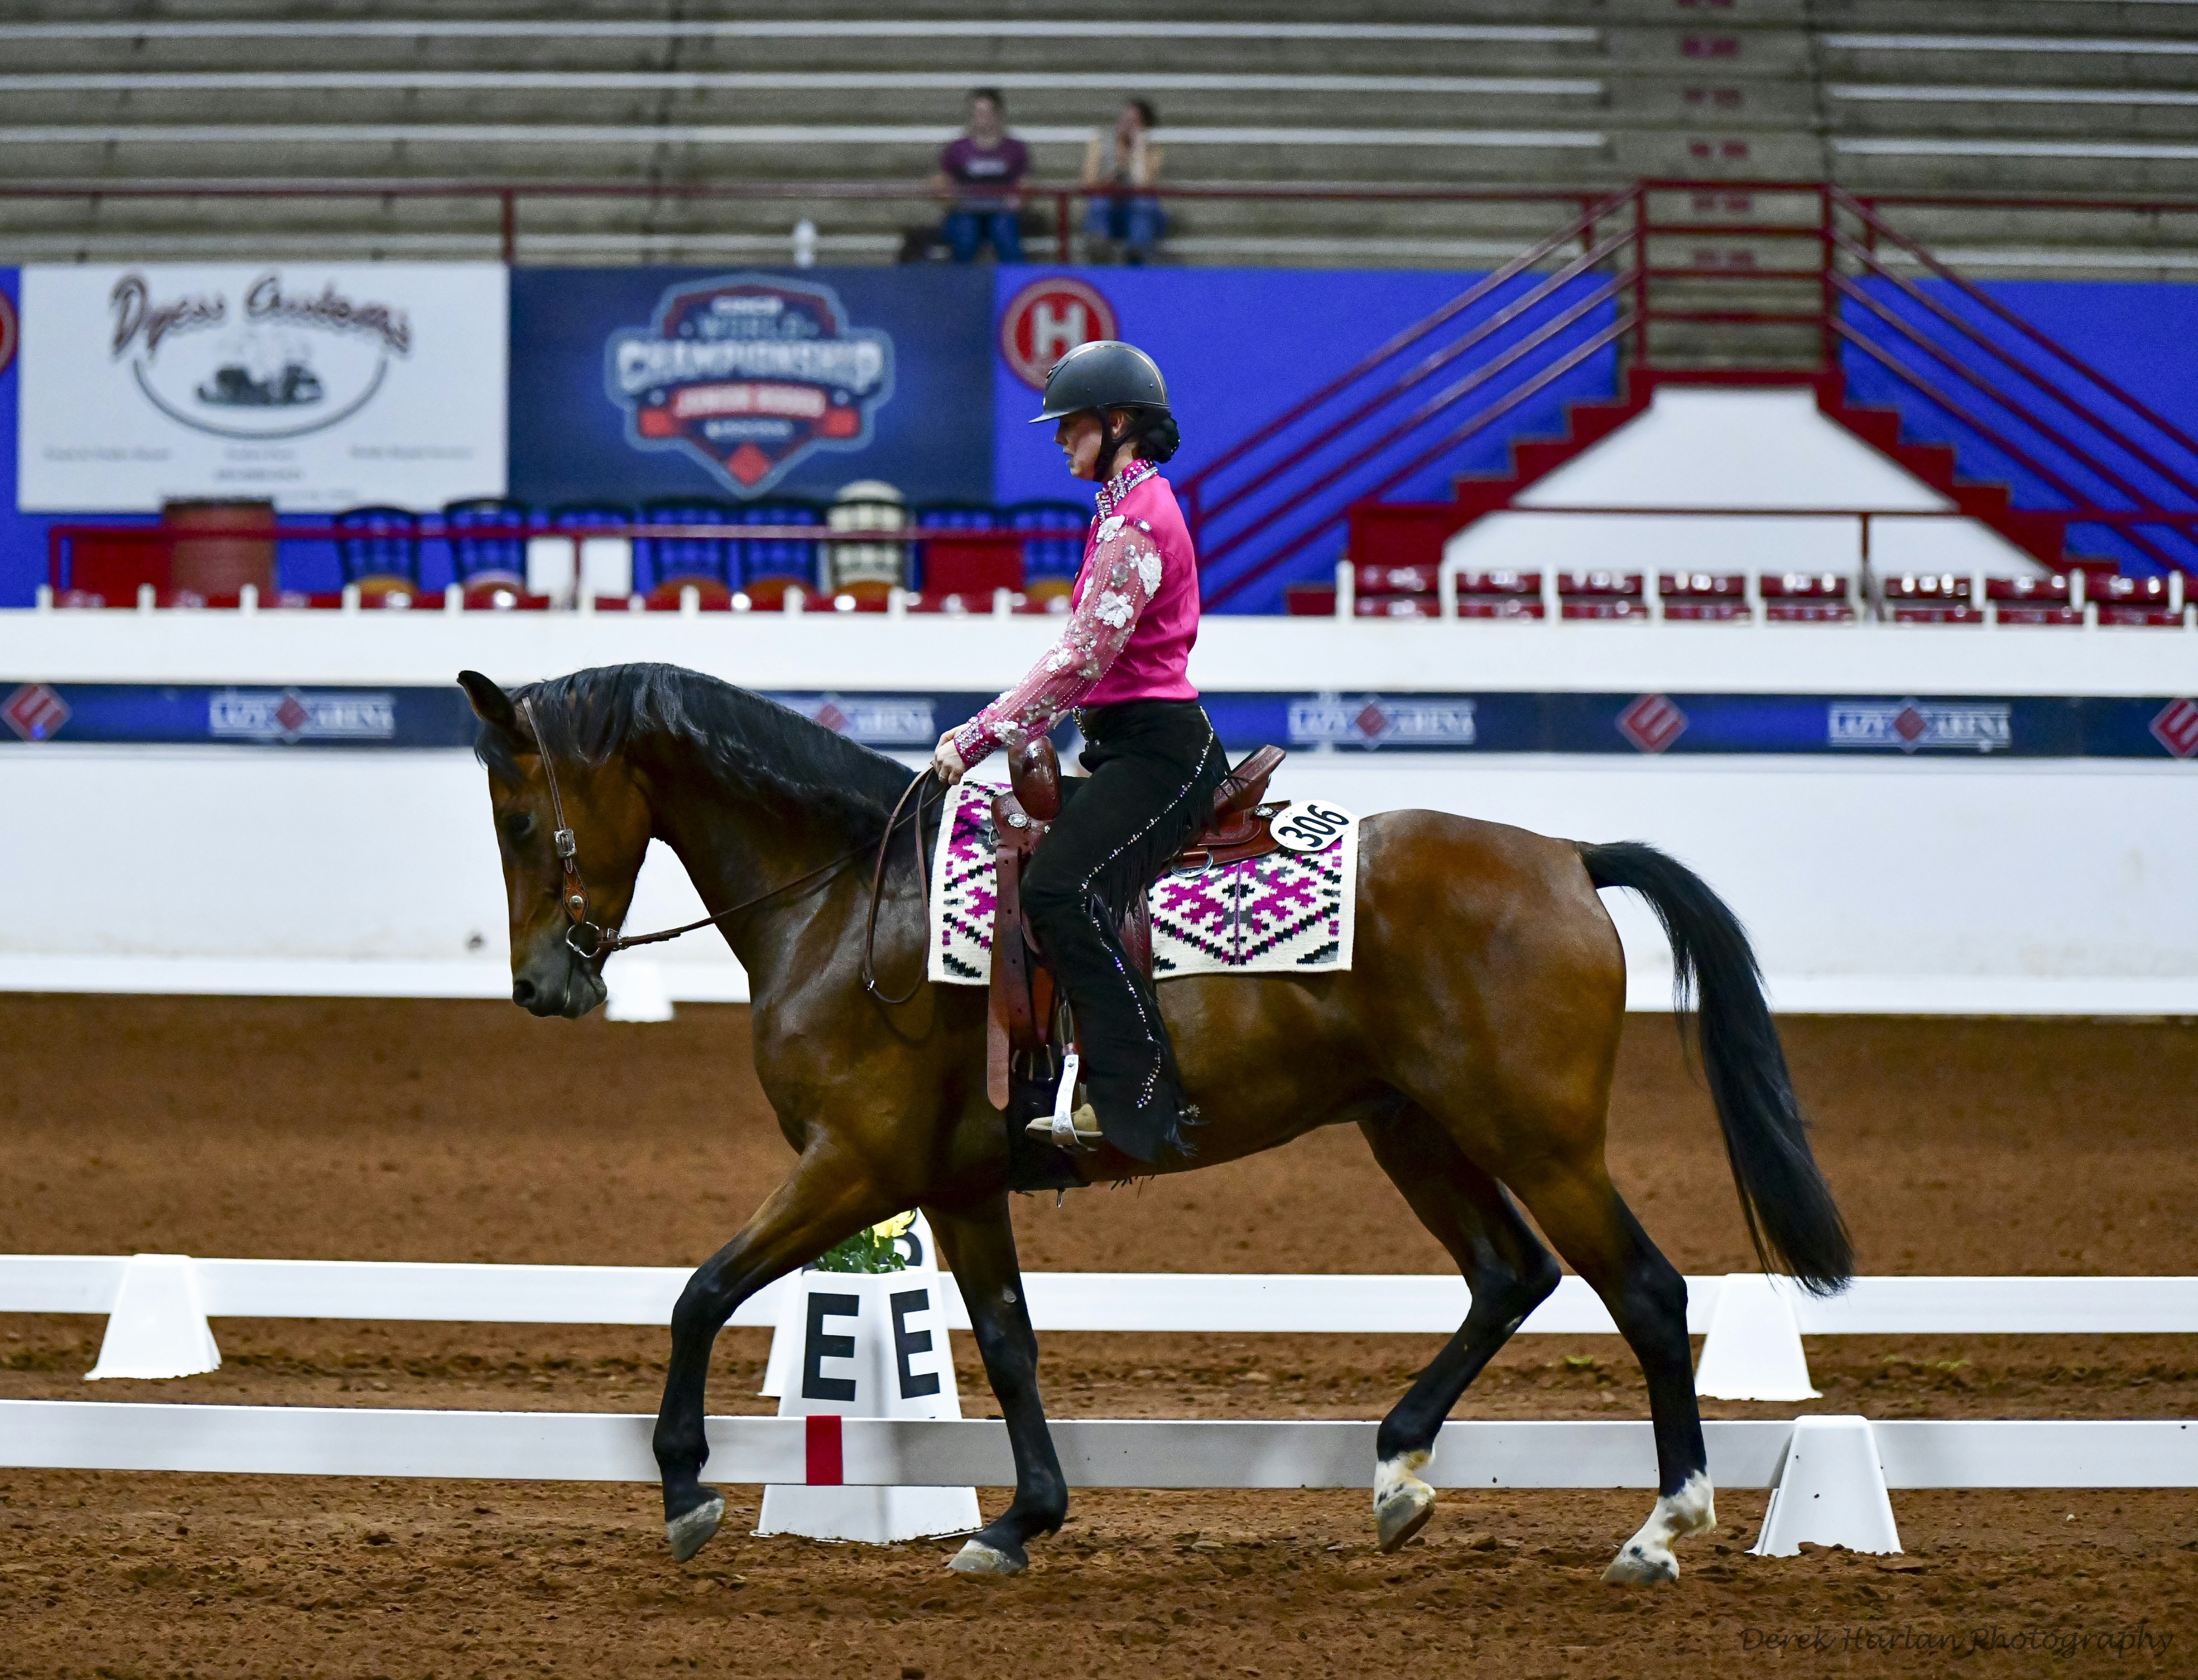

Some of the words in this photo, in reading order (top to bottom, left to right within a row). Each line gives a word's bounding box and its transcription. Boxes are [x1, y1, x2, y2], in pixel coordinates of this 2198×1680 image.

[1033, 302, 1086, 356] H
[1278, 804, 1349, 848] 306
[802, 1292, 860, 1402] E
[890, 1288, 941, 1400] E
